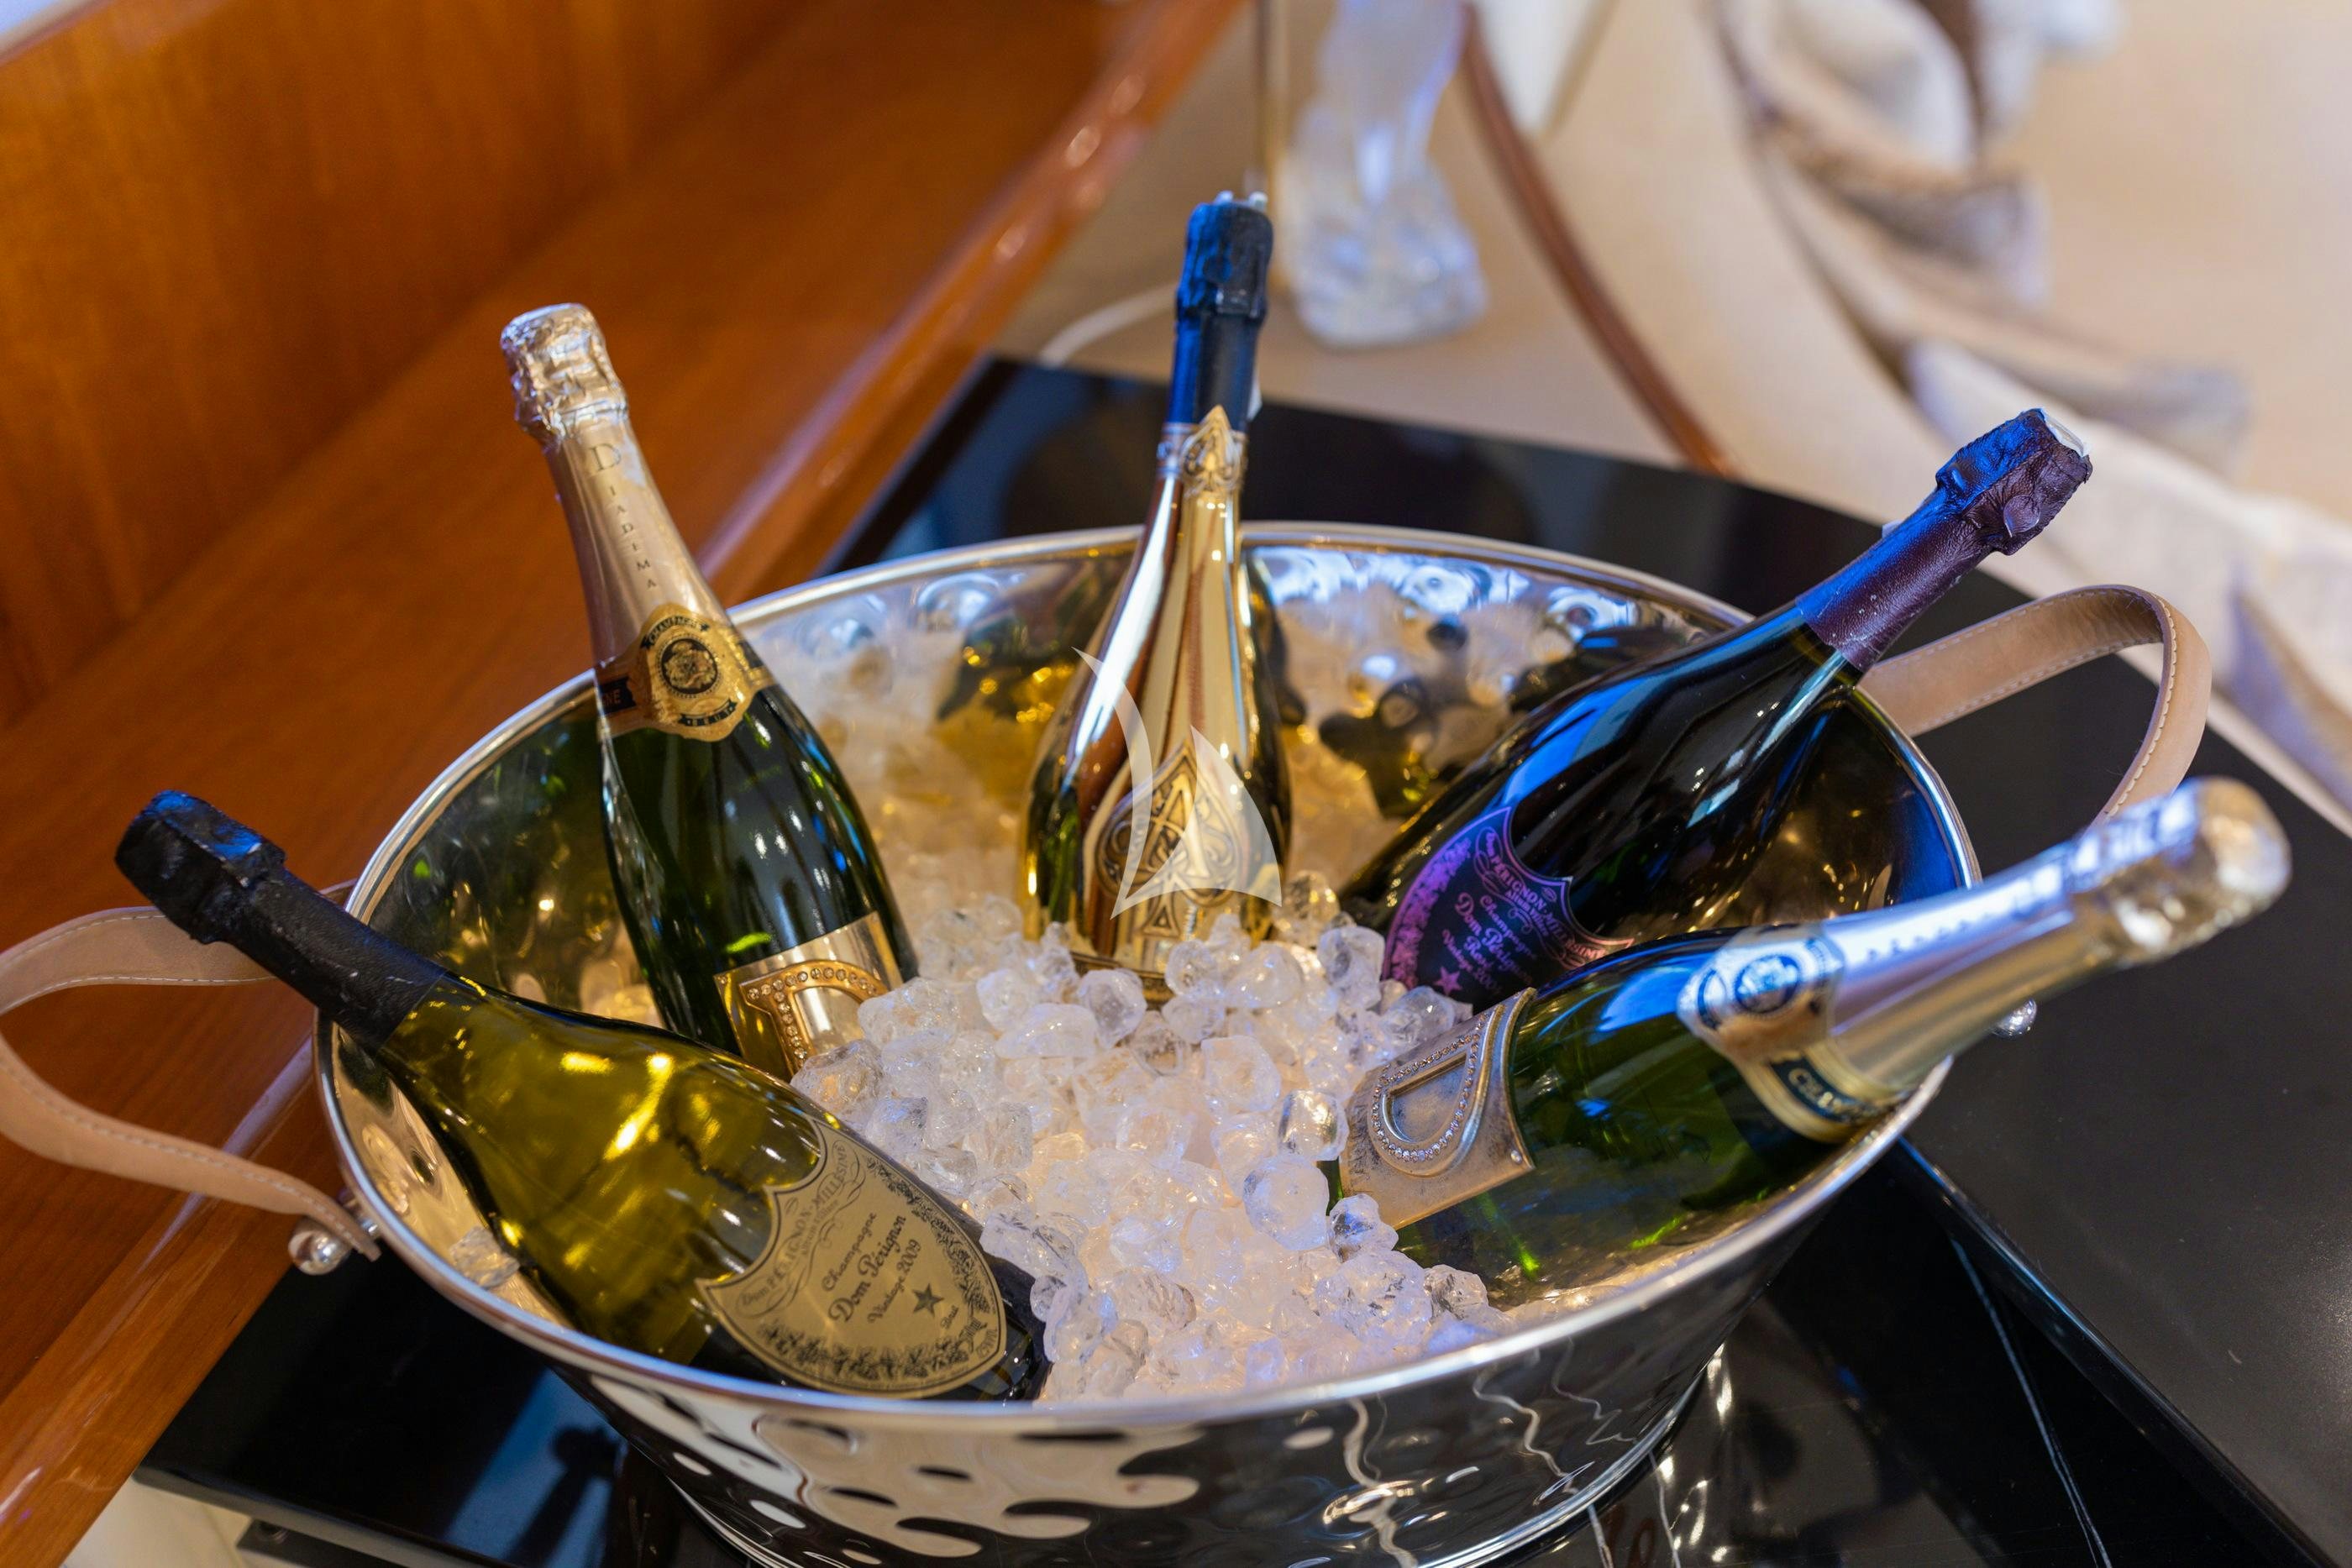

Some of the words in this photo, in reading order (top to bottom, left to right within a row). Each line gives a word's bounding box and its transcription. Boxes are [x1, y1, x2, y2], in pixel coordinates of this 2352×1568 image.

[591, 443, 657, 590] DIADEMA
[1442, 929, 1473, 974] Vintage
[1455, 892, 1482, 936] Dom
[822, 1212, 877, 1292] Champagne
[827, 1282, 870, 1324] Dom
[858, 1215, 907, 1280] Pérignon
[867, 1280, 907, 1324] Vintage
[897, 1239, 922, 1278] 2009
